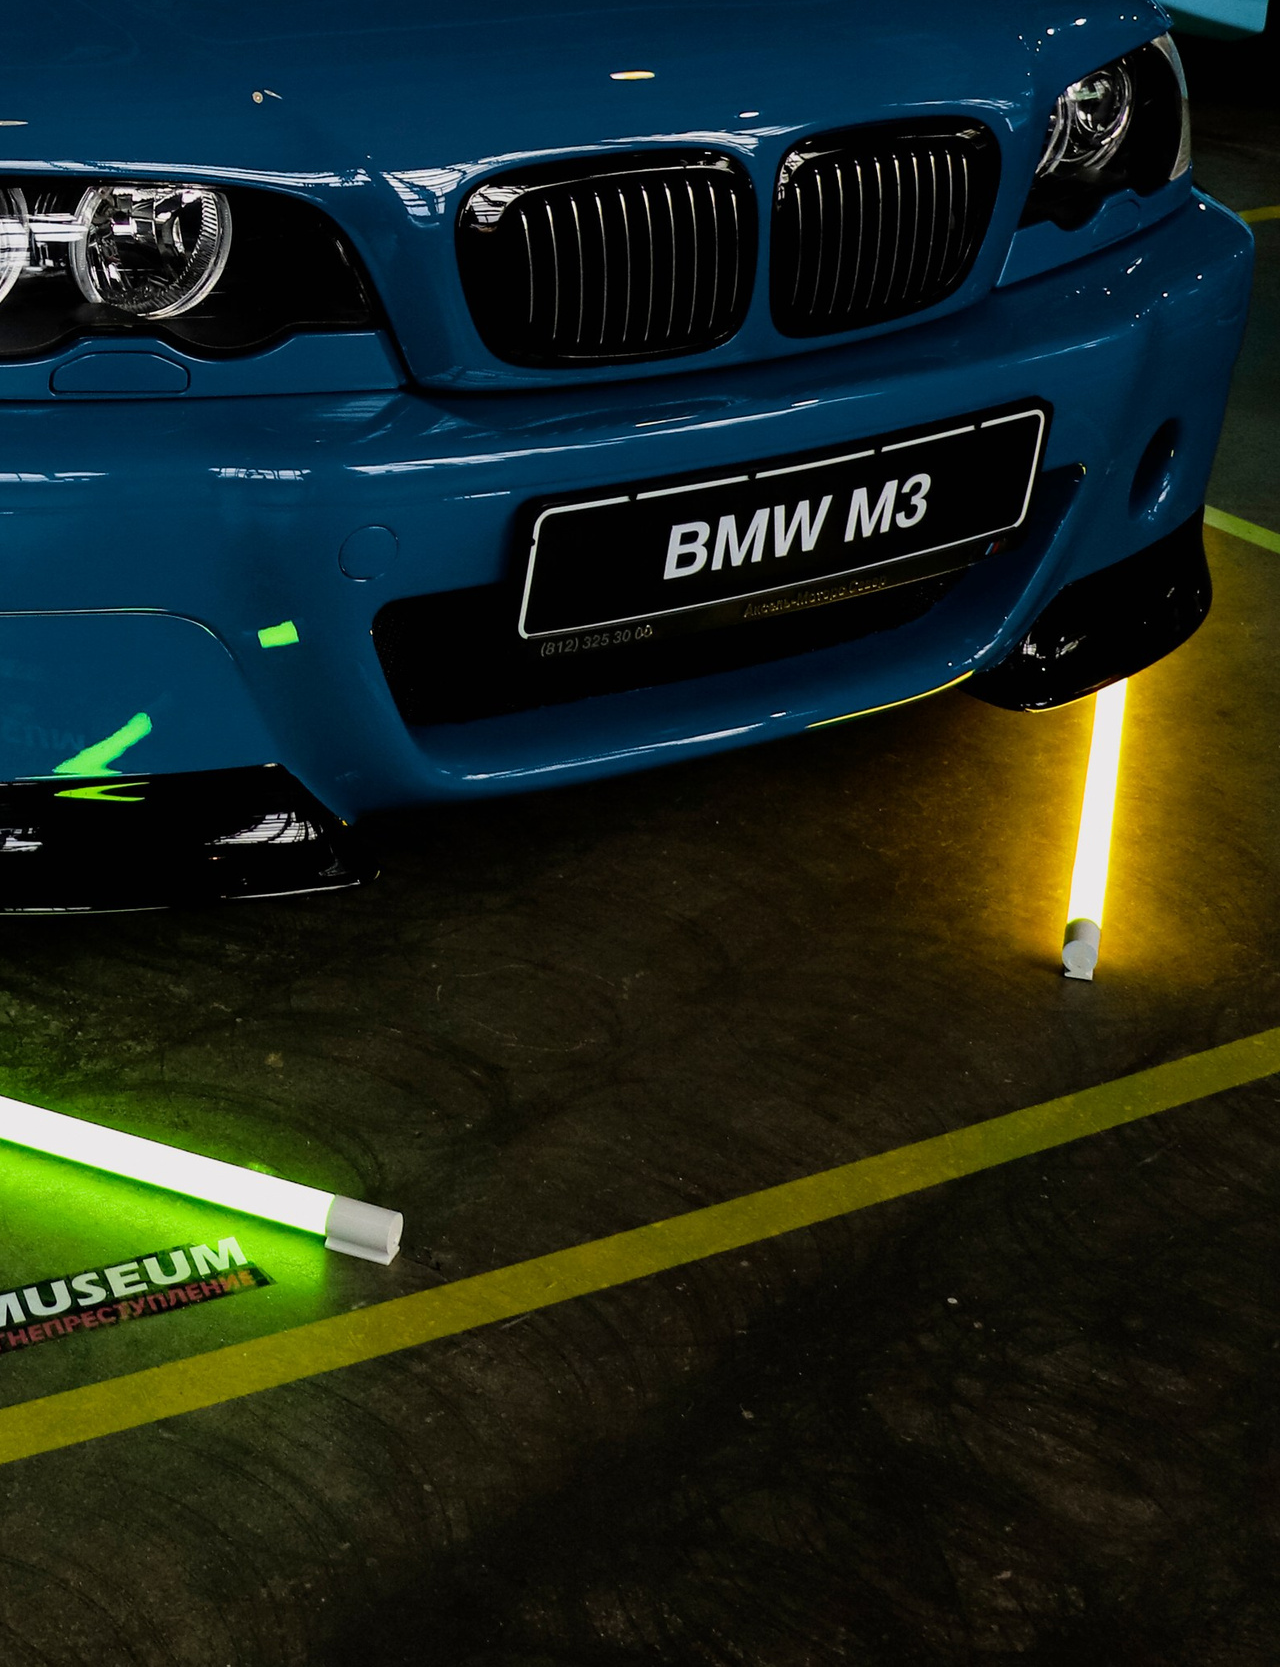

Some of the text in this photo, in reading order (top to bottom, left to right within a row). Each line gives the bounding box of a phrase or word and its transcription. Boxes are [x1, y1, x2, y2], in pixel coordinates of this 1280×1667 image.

[663, 473, 932, 580] BMW M3
[540, 624, 653, 658] (812) 325 30 00
